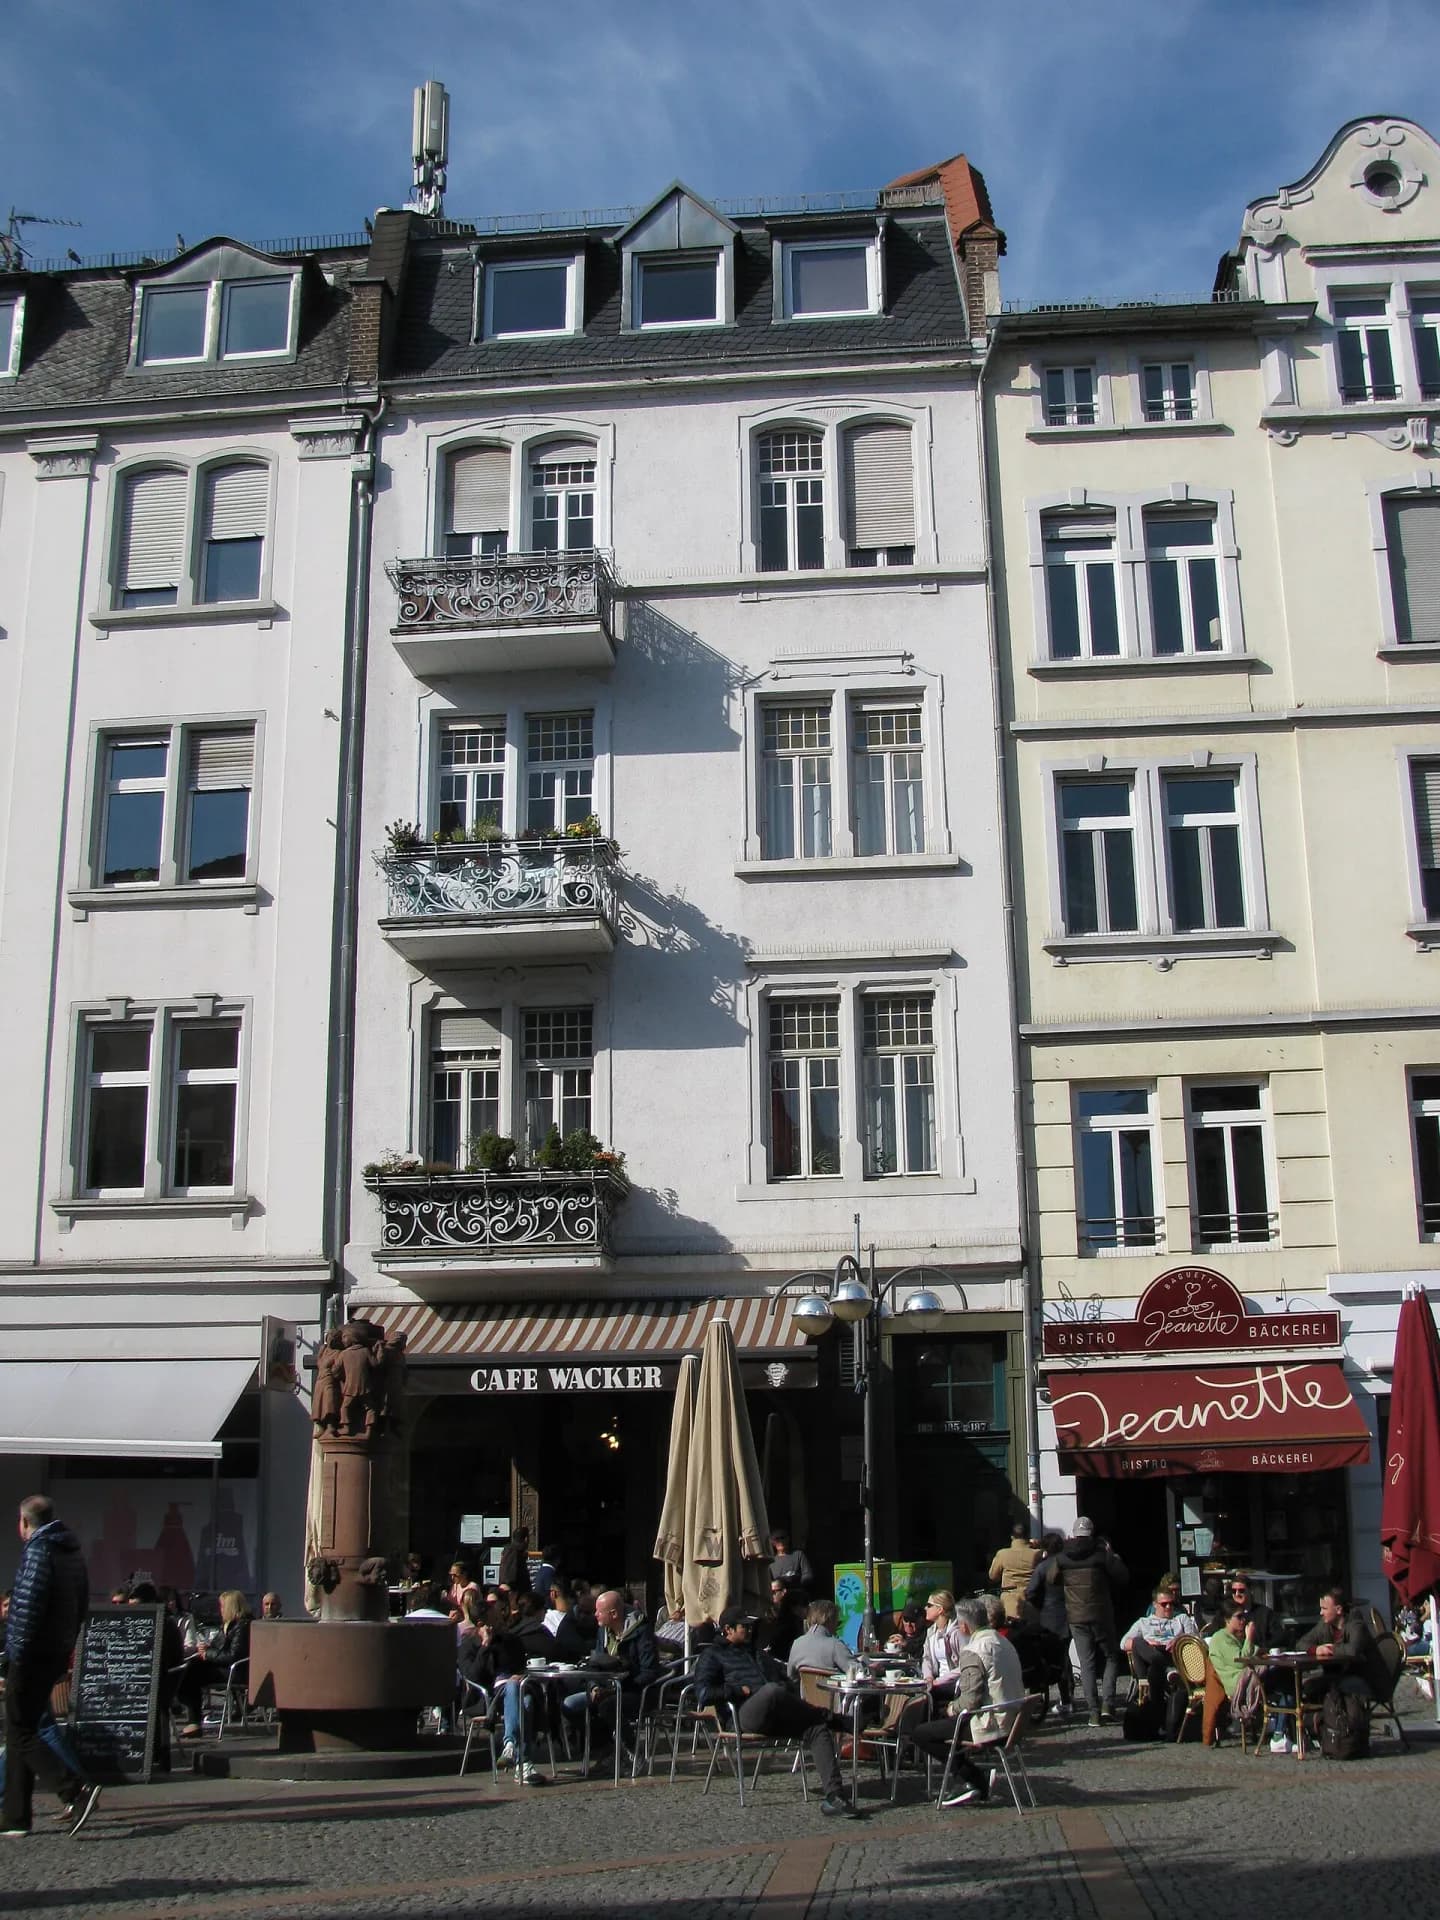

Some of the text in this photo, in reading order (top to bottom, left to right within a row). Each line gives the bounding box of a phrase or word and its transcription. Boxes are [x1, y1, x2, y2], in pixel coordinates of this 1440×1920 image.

[1164, 1271, 1218, 1290] BAGUETTE
[1058, 1322, 1327, 1345] BISTRO BÄCKEREI
[1143, 1310, 1239, 1347] Jeanette
[470, 1365, 663, 1391] CAFE WACKER
[1052, 1364, 1353, 1447] Jeanette
[1121, 1452, 1314, 1471] BISTRO BÄCKEREI
